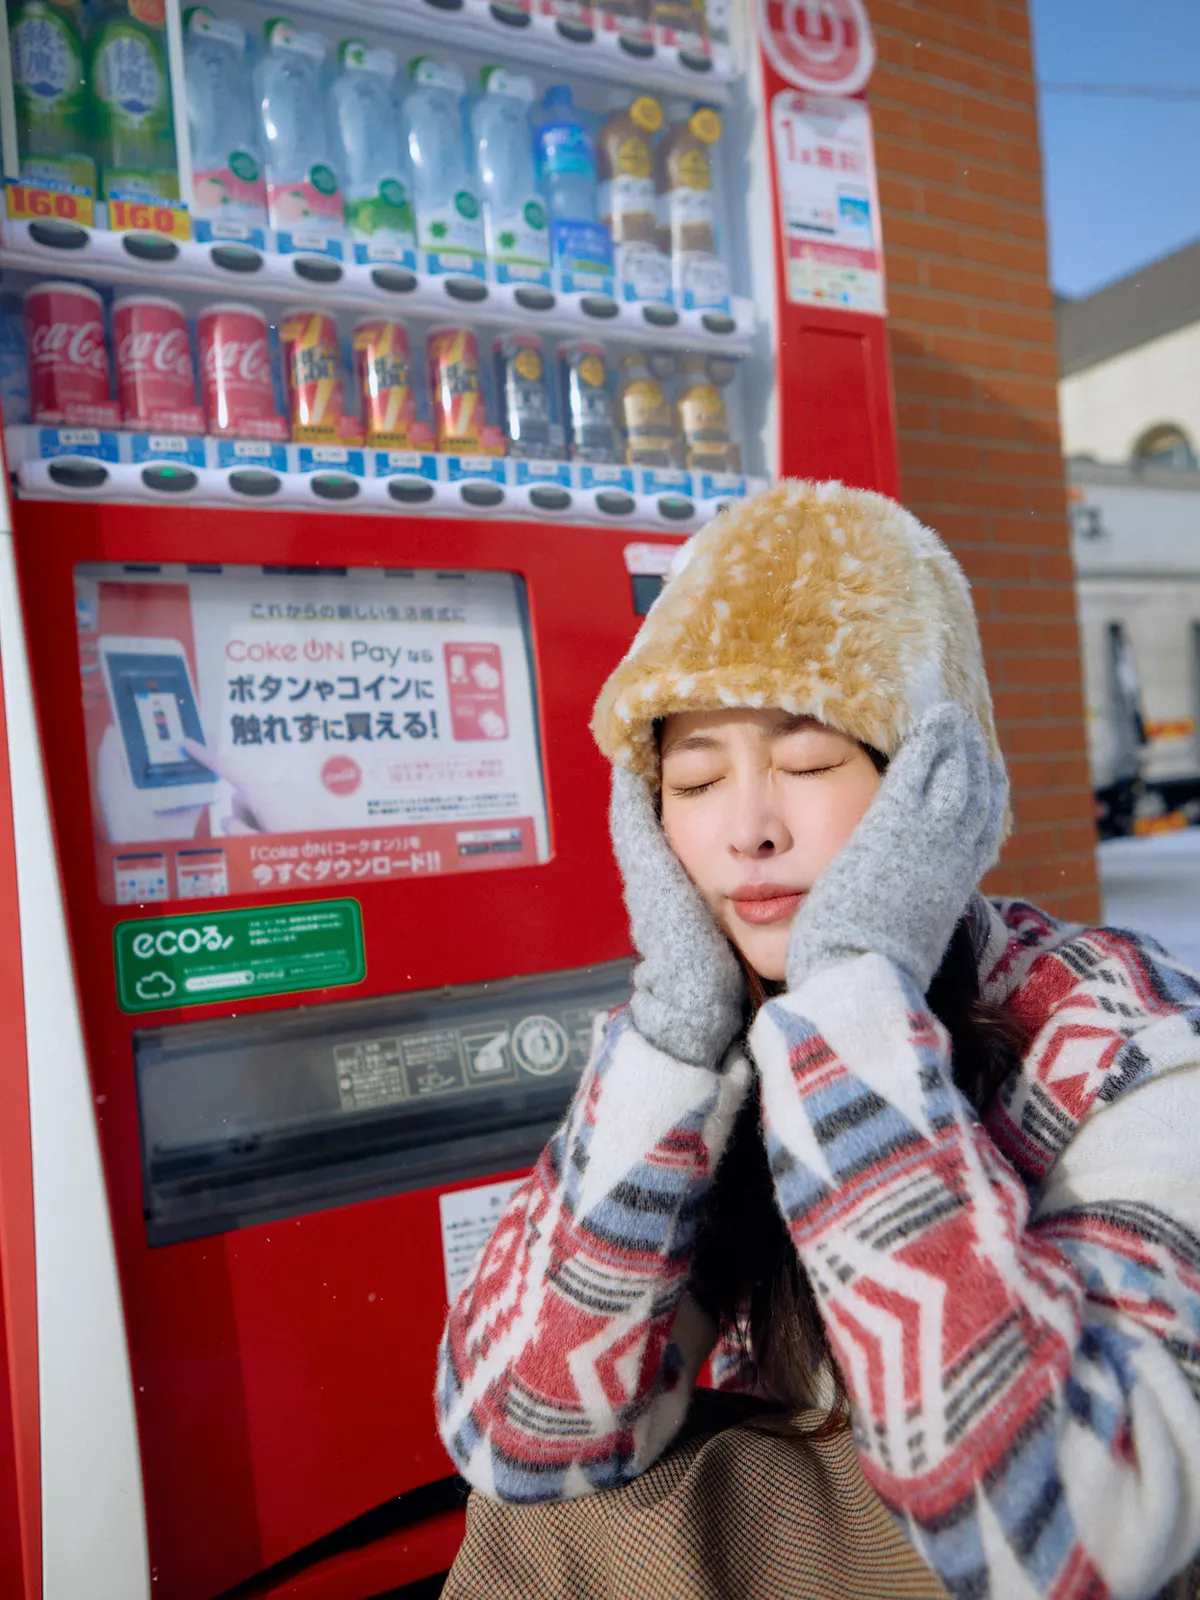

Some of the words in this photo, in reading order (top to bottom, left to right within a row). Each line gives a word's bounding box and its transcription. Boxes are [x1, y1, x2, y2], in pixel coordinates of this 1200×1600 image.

[11, 185, 77, 219] 160
[113, 201, 174, 233] 160
[225, 640, 297, 662] Coke
[351, 640, 402, 667] Pay
[228, 674, 434, 703] ボタンやコインに
[230, 711, 440, 745] 触れずに買える!
[252, 850, 442, 886] 今すぐダウンロード!!
